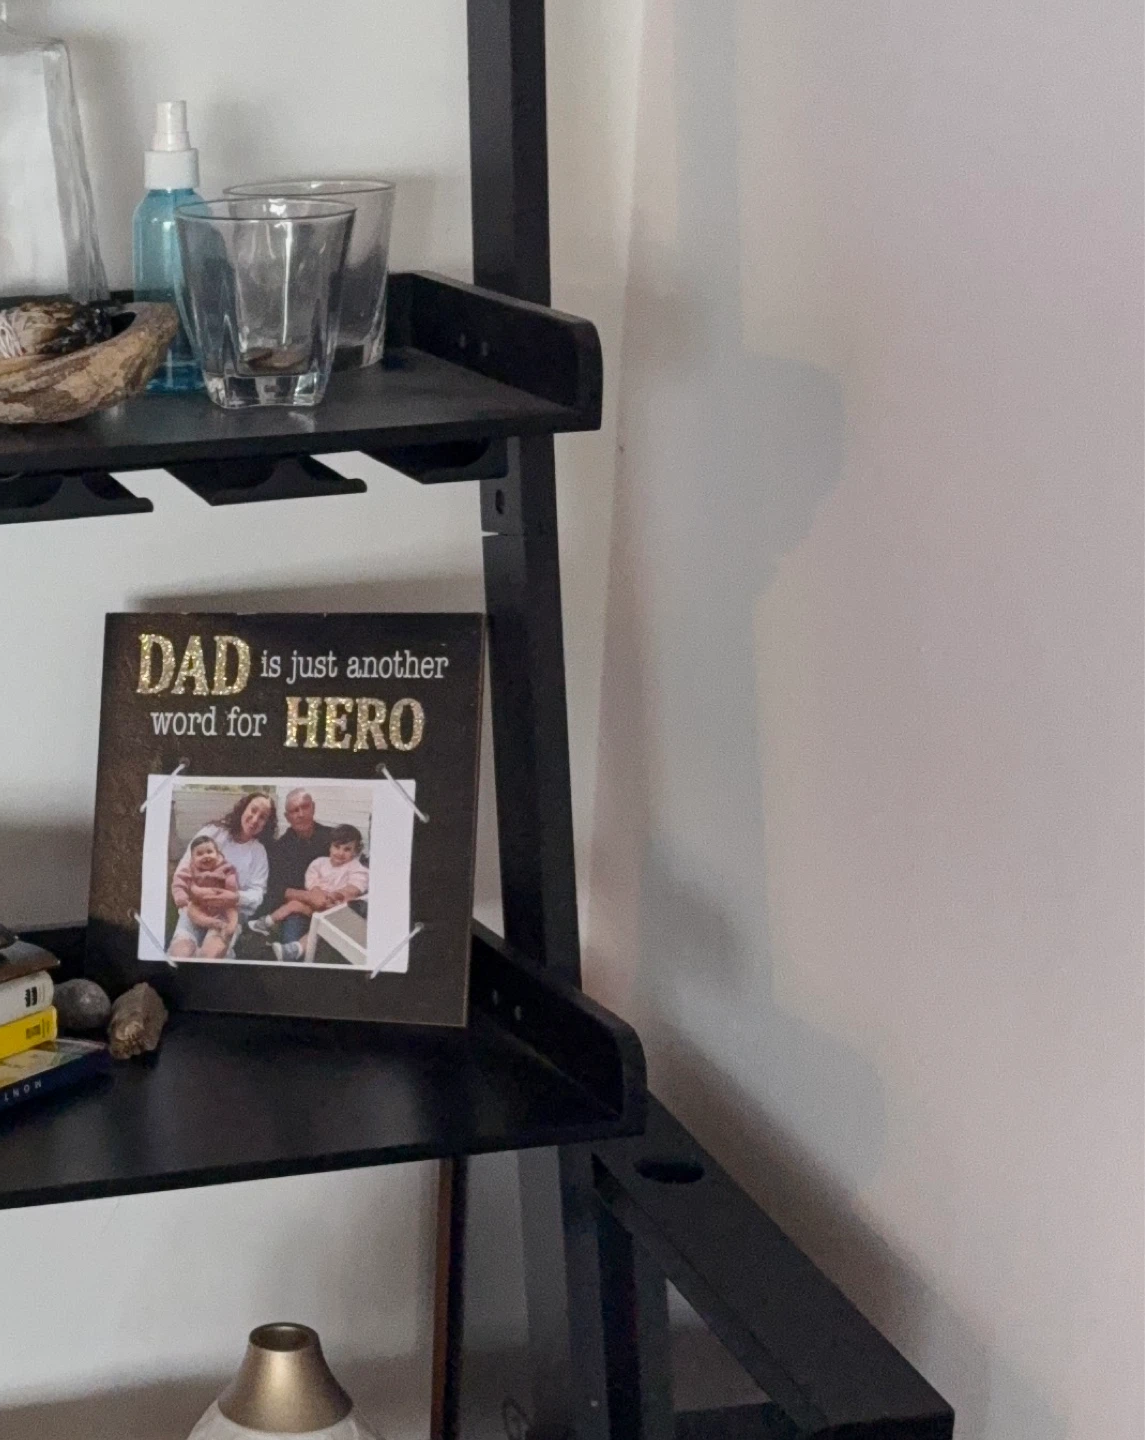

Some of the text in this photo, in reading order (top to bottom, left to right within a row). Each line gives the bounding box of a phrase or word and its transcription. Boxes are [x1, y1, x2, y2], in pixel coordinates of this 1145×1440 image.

[136, 633, 450, 696] DAD is just another
[149, 695, 427, 752] word for HERO
